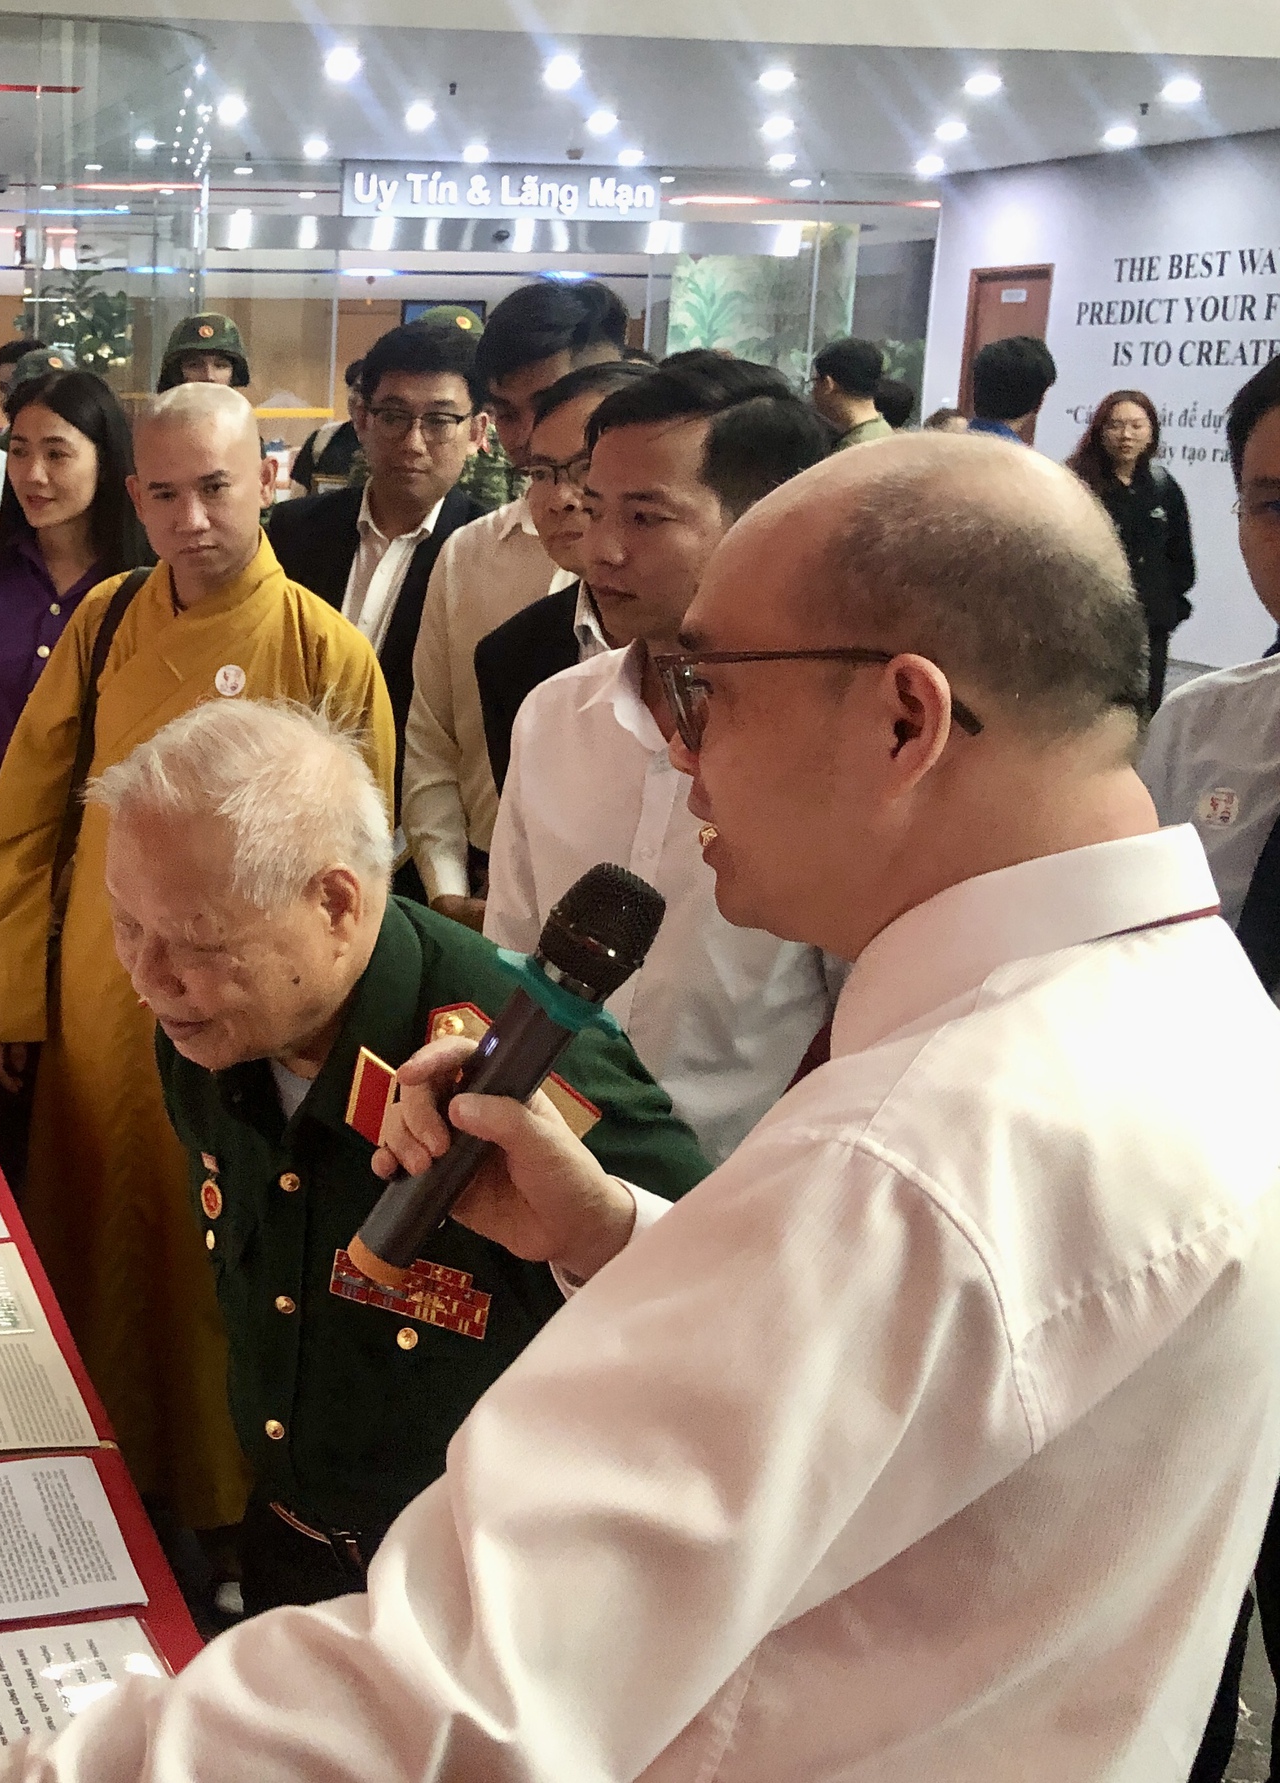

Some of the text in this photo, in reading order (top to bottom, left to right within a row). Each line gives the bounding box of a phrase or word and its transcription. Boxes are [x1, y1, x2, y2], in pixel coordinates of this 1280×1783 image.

[354, 171, 655, 216] Uy Tín & Lãng Mạn
[1114, 248, 1280, 283] THE BEST WA
[1076, 293, 1280, 326] PREDICT YOUR F
[1112, 341, 1133, 367] IS
[1139, 340, 1172, 367] TO
